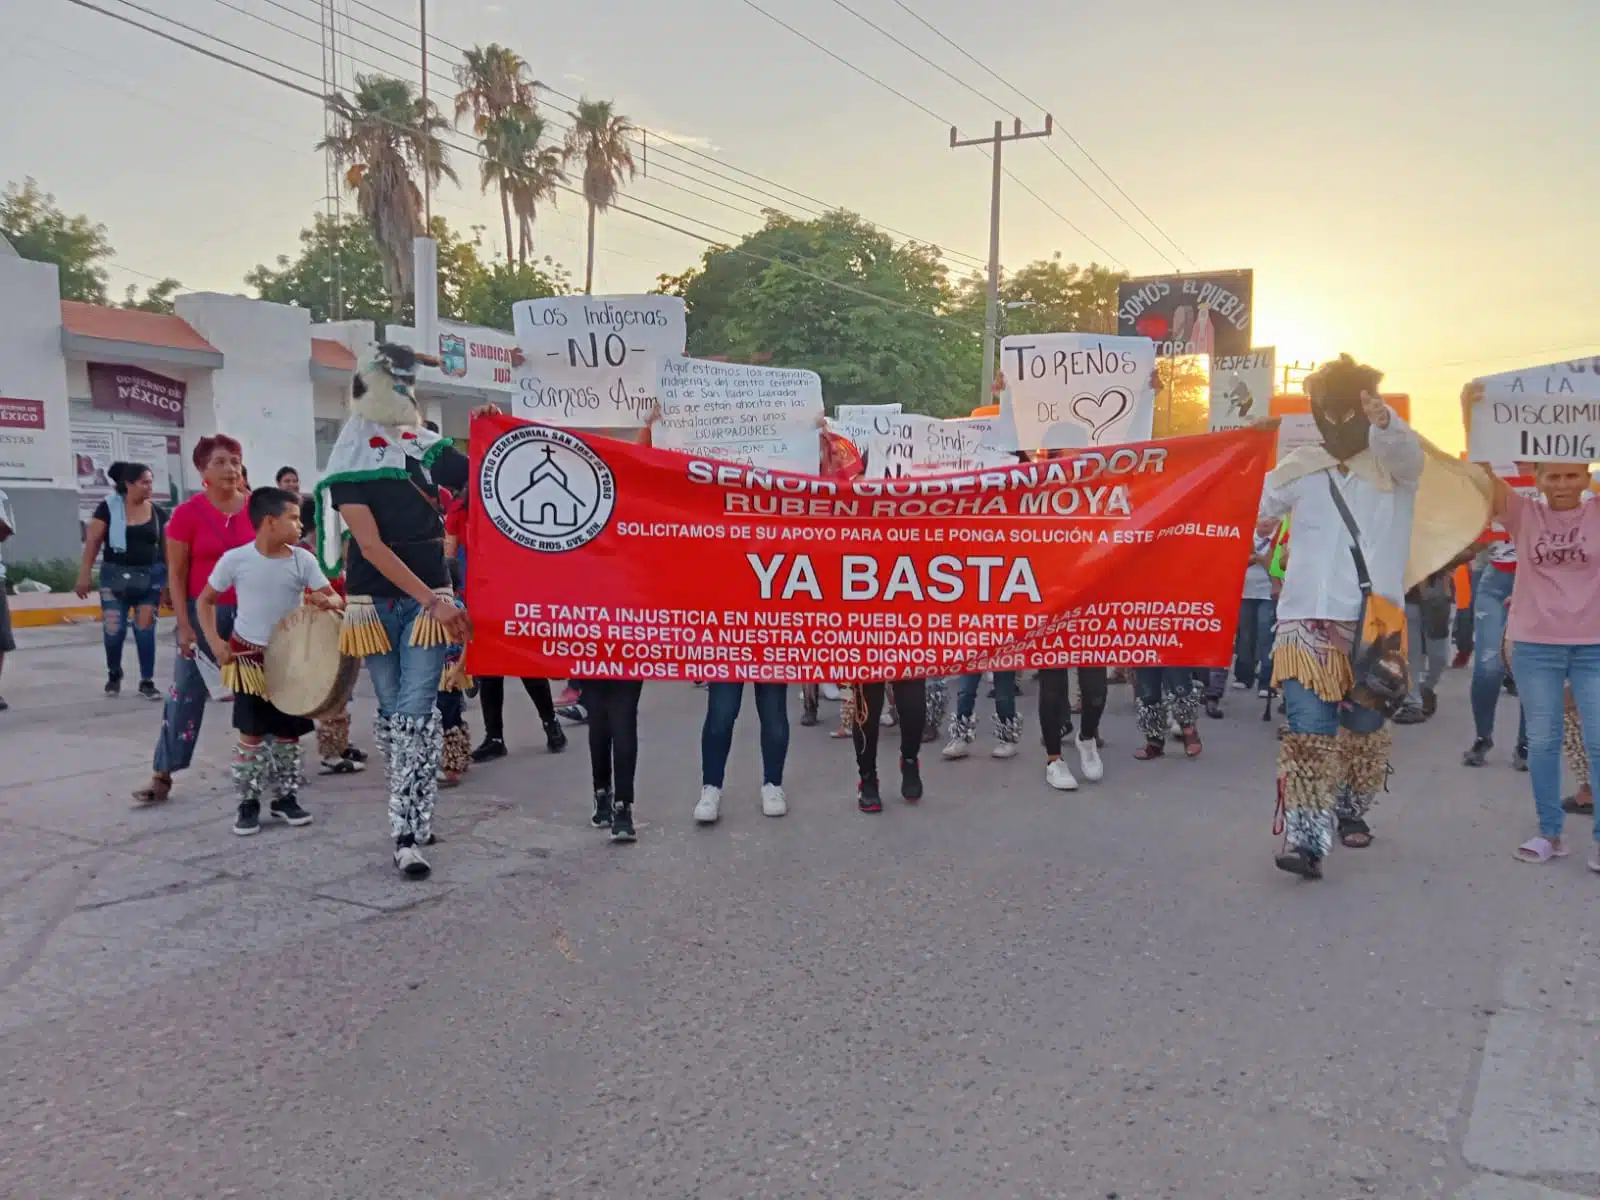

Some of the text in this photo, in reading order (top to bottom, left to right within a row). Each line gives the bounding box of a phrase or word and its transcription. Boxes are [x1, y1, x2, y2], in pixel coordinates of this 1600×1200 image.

[529, 305, 568, 326] Los
[1119, 279, 1249, 330] SOMOS EL PUEBLO
[118, 384, 182, 412] MÉXICO
[1546, 376, 1575, 394] LA
[1037, 400, 1061, 422] DE
[1493, 402, 1600, 425] DISCRIMI
[1521, 431, 1600, 458] INDIG
[483, 458, 497, 500] CENTRO
[492, 430, 549, 459] CEREMONIAL
[551, 431, 573, 445] SAN
[574, 441, 596, 463] JOSE
[600, 471, 612, 500] TORO
[852, 448, 1168, 496] GOBERNADOR
[725, 485, 1130, 517] RUBEN ROCHA MOYA
[493, 515, 513, 538] JUAN
[513, 532, 536, 547] JOSE
[617, 522, 1241, 544] SOLICITAMOS DE SU APOYO PARA QUE LE PONGA SOLUCIÓN A ESTE PROBLEMA
[746, 553, 1043, 603] YA BASTA
[515, 603, 542, 618] DE
[548, 604, 610, 621] TANTA
[616, 607, 718, 625] INJUSTICIA
[724, 611, 748, 626] EN
[754, 611, 842, 627] NUESTRO
[848, 613, 922, 628] PUEBLO
[928, 613, 952, 628] DE
[959, 614, 1018, 629] PARTE
[1024, 614, 1048, 629] DE
[1085, 601, 1215, 616] AUTORIDADES
[504, 621, 602, 639] EXIGIMOS
[608, 625, 696, 642] RESPETO
[702, 630, 714, 643] A
[720, 630, 806, 644] NUESTRA
[811, 631, 923, 645] COMUNIDAD
[1024, 618, 1101, 639] RESPETO
[1106, 618, 1118, 631] A
[1123, 617, 1222, 632] NUESTROS
[542, 641, 598, 657] USOS
[604, 642, 616, 658] Y
[763, 647, 861, 662] SERVICIOS
[866, 648, 937, 663] DIGNOS
[942, 649, 989, 663] PARA
[994, 640, 1037, 658] TODA
[1042, 635, 1064, 649] LA
[1069, 633, 1183, 649] CIUDADANIA,
[570, 660, 624, 677] JUAN
[629, 661, 679, 677] JOSE
[685, 663, 729, 678] RIOS
[735, 664, 825, 680] NECESITA
[830, 665, 897, 680] MUCHO
[900, 663, 961, 679] APOYO
[1031, 650, 1162, 666] GOBERNADOR.
